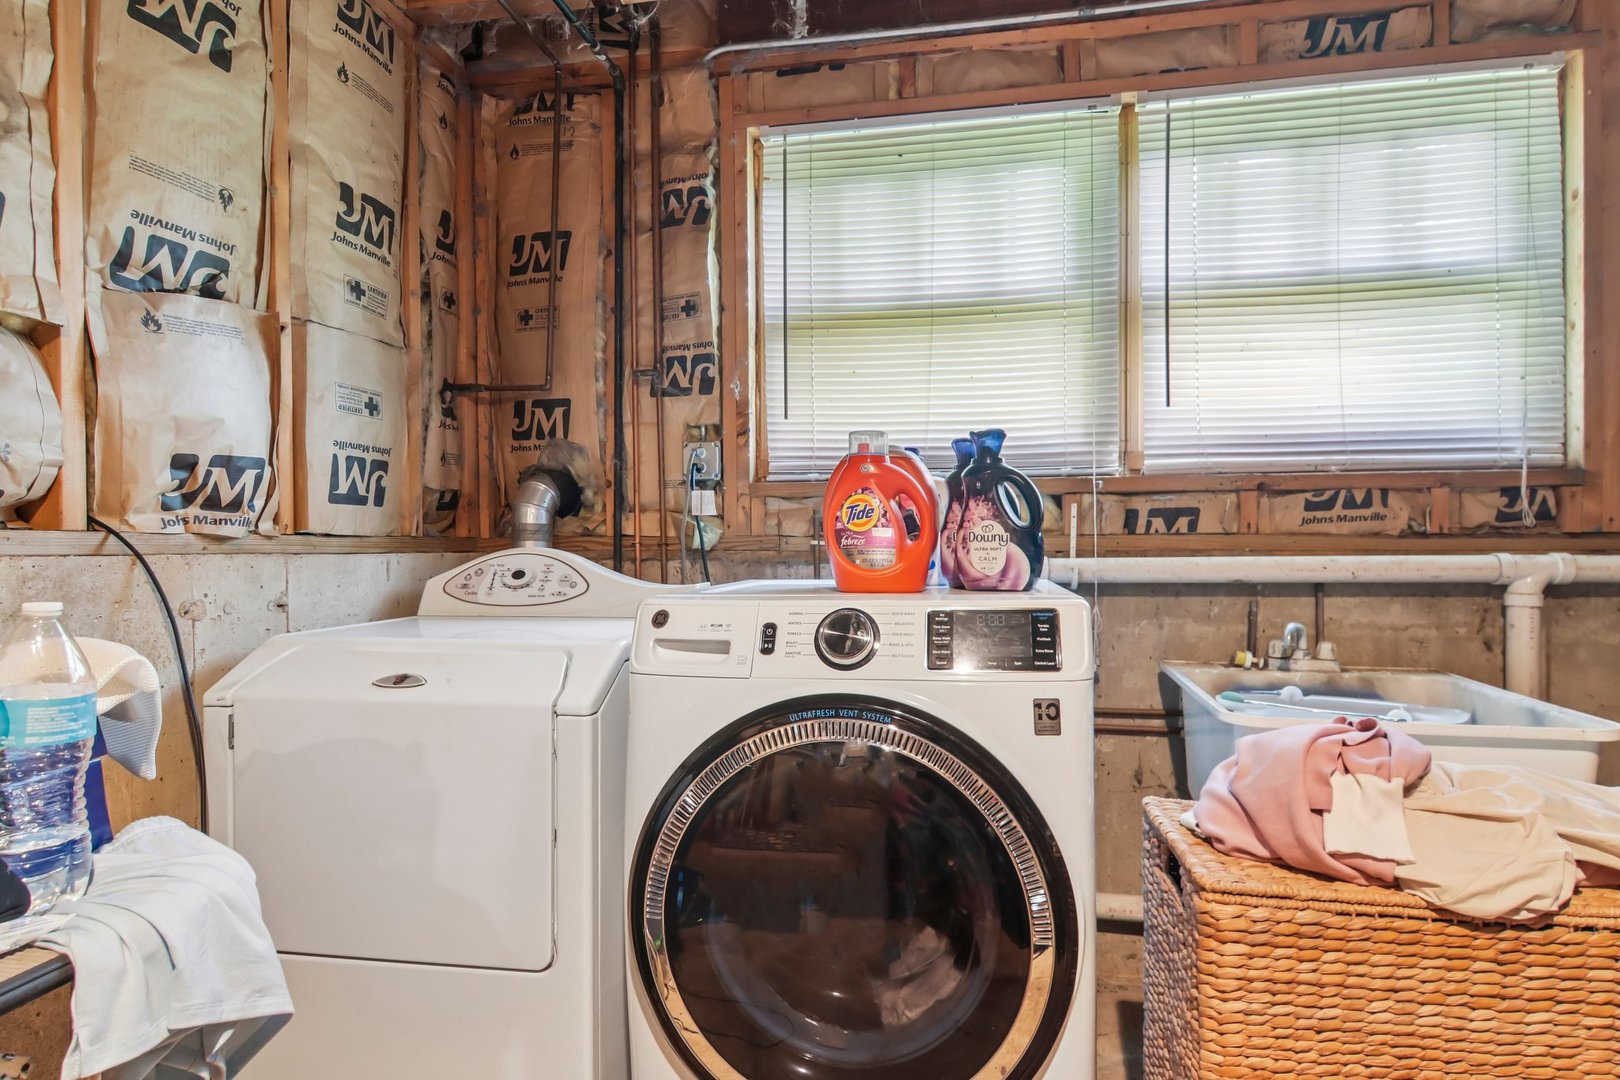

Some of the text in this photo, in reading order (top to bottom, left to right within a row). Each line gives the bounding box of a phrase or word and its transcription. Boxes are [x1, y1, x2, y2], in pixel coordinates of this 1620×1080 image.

[127, 0, 236, 73] JM
[332, 23, 393, 76] Johns Manville
[337, 0, 394, 64] JM
[1299, 13, 1391, 58] JM
[508, 117, 532, 127] Johns
[130, 209, 236, 255] Johns Manville
[336, 181, 395, 255] JM
[109, 226, 230, 299] JM
[331, 231, 391, 267] Johns Manville
[509, 230, 572, 277] JM
[507, 280, 527, 289] Johns
[650, 353, 716, 397] JM
[512, 398, 571, 440] JM
[333, 440, 392, 457] Johns Manville
[510, 444, 532, 453] Johns
[161, 453, 266, 513] JM
[328, 453, 389, 507] JM
[846, 504, 875, 525] Tide
[1299, 512, 1388, 527] Johns Manville
[840, 535, 866, 548] febreze
[968, 531, 1009, 546] Downy
[789, 709, 891, 723] ULTRAFRESH VENT SYSTEM
[1034, 702, 1059, 721] 10
